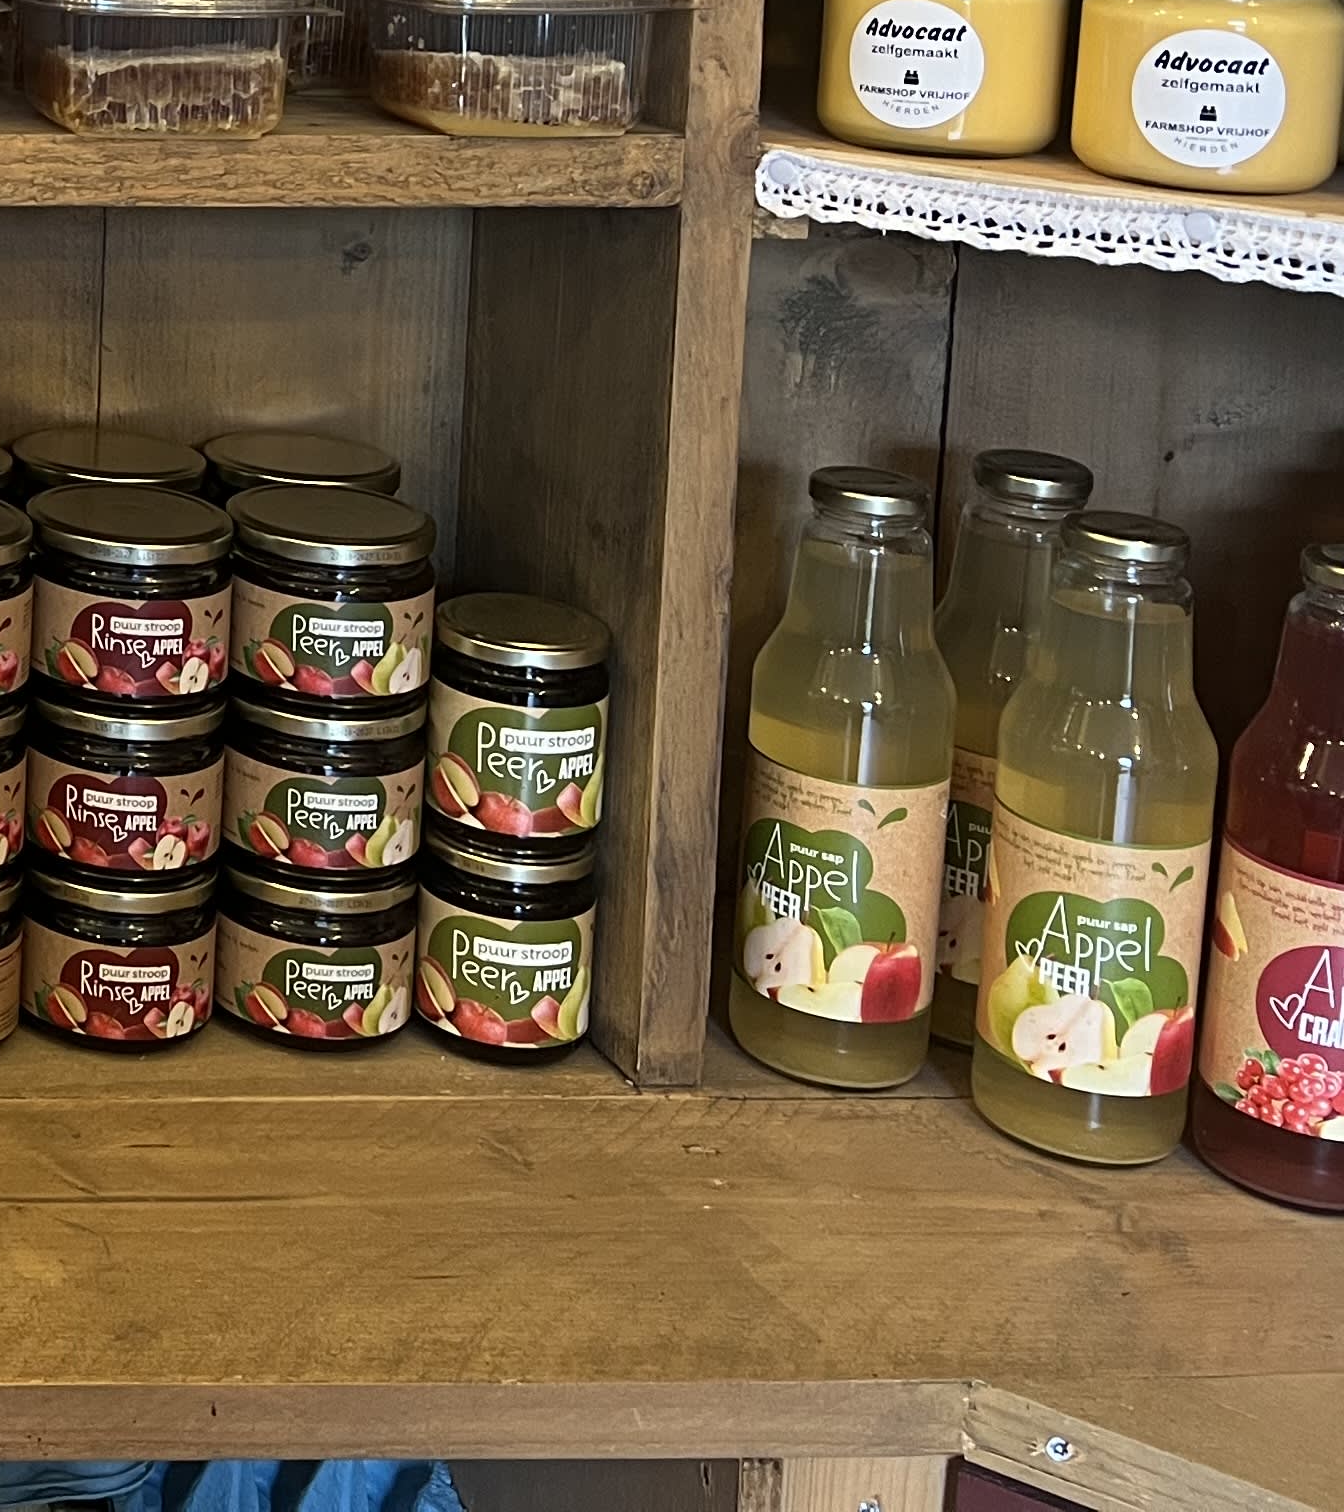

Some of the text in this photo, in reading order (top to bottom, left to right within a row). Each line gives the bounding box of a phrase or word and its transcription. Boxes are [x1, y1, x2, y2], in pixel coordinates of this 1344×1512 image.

[866, 17, 967, 41] Advocaat
[871, 44, 959, 59] zelfgemaakt
[1154, 50, 1269, 75] Advocaat
[859, 84, 970, 101] FARMSHOP VRIJHOF
[1162, 78, 1260, 94] zelfgemaakt
[1145, 120, 1270, 137] FARMSHOP VRIJHOF
[92, 613, 183, 657] Rinse APPEL
[113, 621, 181, 633] puur stroop
[292, 613, 383, 657] Peer APPEL
[312, 622, 382, 634] puur stroop
[477, 722, 593, 781] Peer APPEL
[505, 734, 592, 748] puur stroop
[66, 783, 157, 831] Rinse APPEL
[86, 793, 154, 808] puur stroop
[288, 788, 377, 830] Peer APPEL
[307, 796, 375, 808] puur stroop
[790, 842, 819, 858] puur
[761, 822, 858, 912] Appel
[761, 881, 801, 921] PEER
[1077, 915, 1138, 934] puur sap
[478, 942, 569, 960] puur stroop
[1039, 895, 1152, 986] Appel
[453, 929, 572, 992] Peer APPEL
[81, 959, 170, 1004] Rinse APPEL
[102, 968, 168, 978] puur stroop
[285, 959, 373, 1001] Peer APPEL
[305, 967, 371, 977] puur stroop
[1039, 957, 1090, 998] PEER
